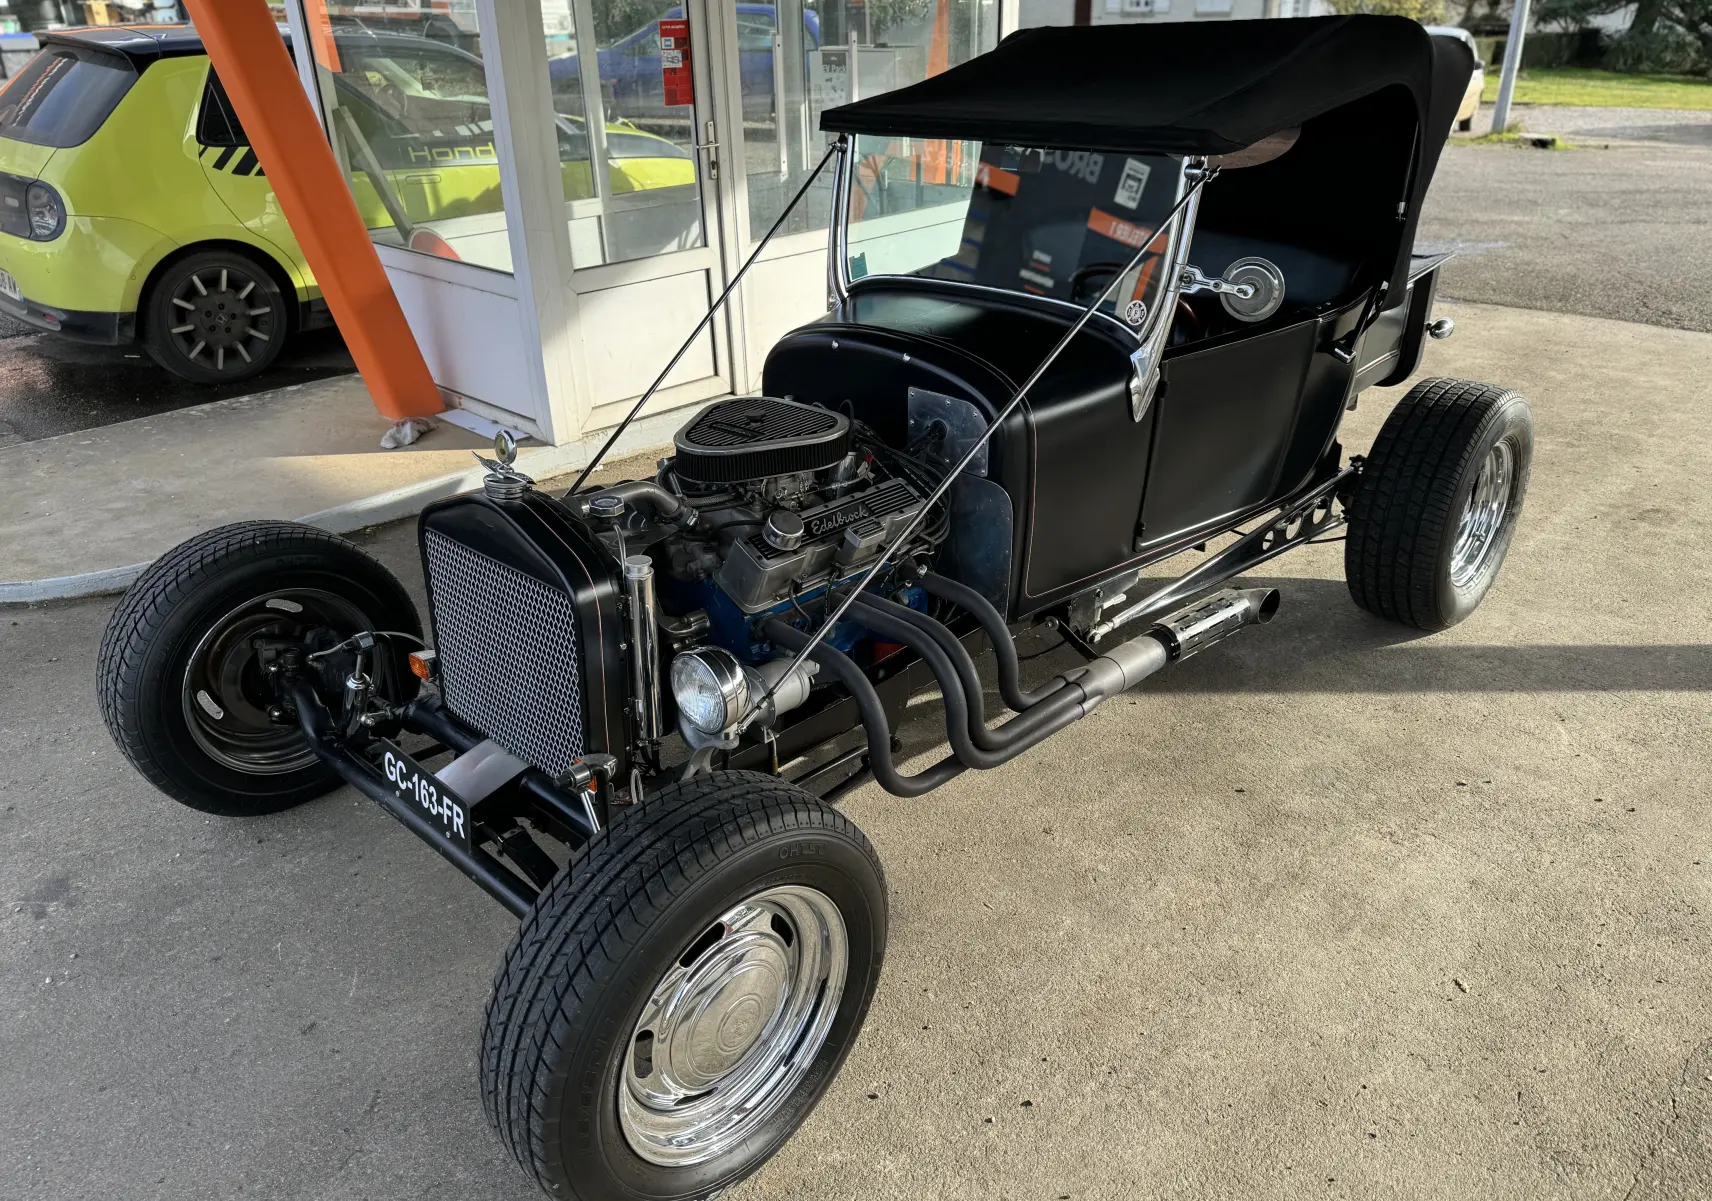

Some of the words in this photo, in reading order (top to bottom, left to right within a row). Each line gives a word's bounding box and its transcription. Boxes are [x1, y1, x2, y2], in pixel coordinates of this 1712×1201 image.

[408, 142, 496, 162] Hond
[811, 506, 869, 535] Edelbrock
[384, 751, 466, 839] GC-163-FR
